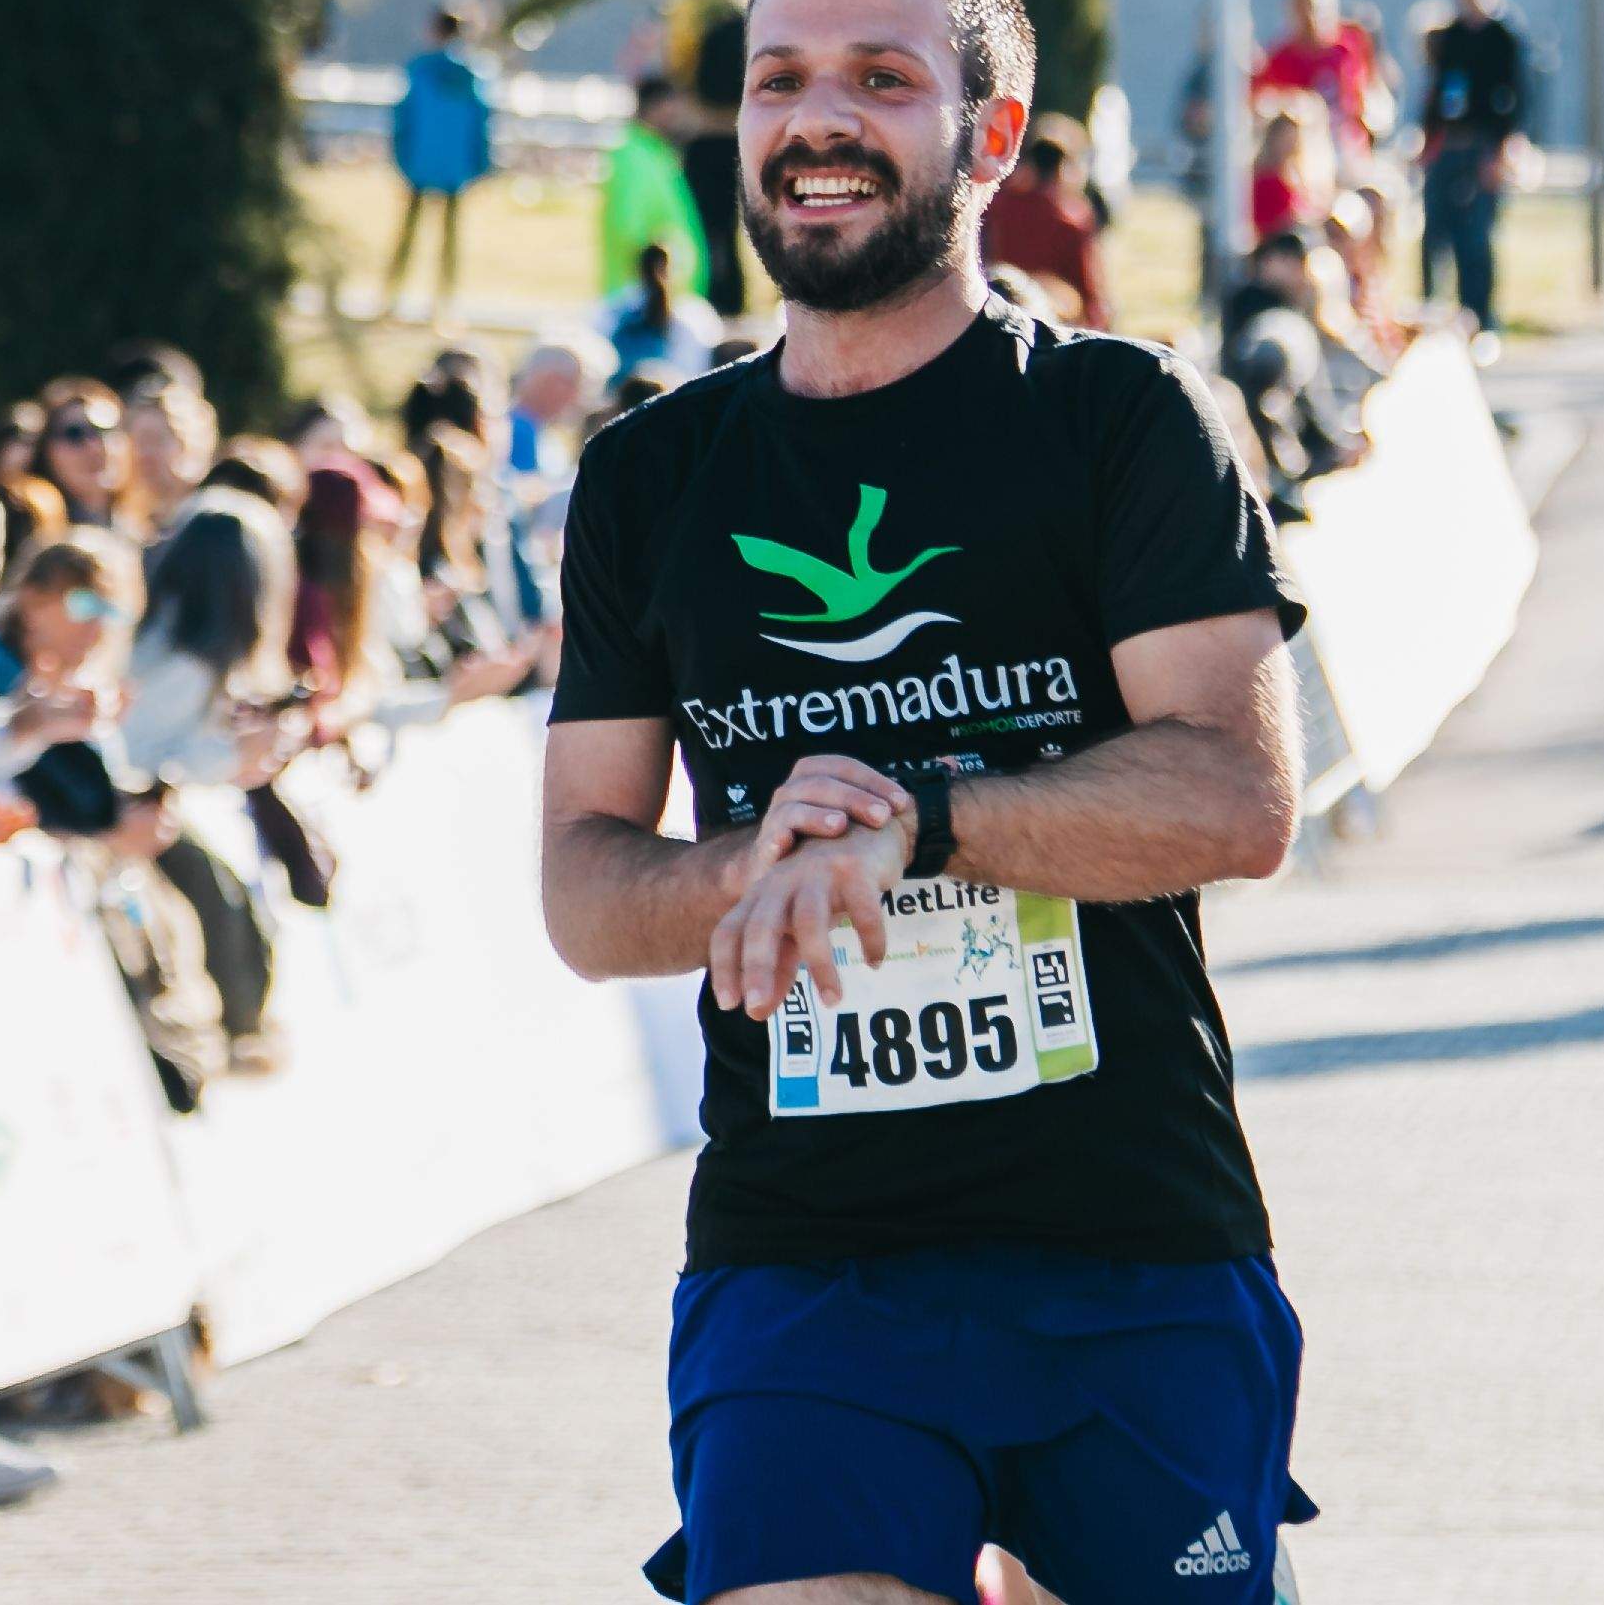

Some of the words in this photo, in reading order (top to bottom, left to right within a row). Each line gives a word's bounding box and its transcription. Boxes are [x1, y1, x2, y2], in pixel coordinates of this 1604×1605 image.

[681, 652, 1079, 750] Extremadura
[830, 995, 1018, 1089] 4895
[1174, 1550, 1251, 1576] adidas
